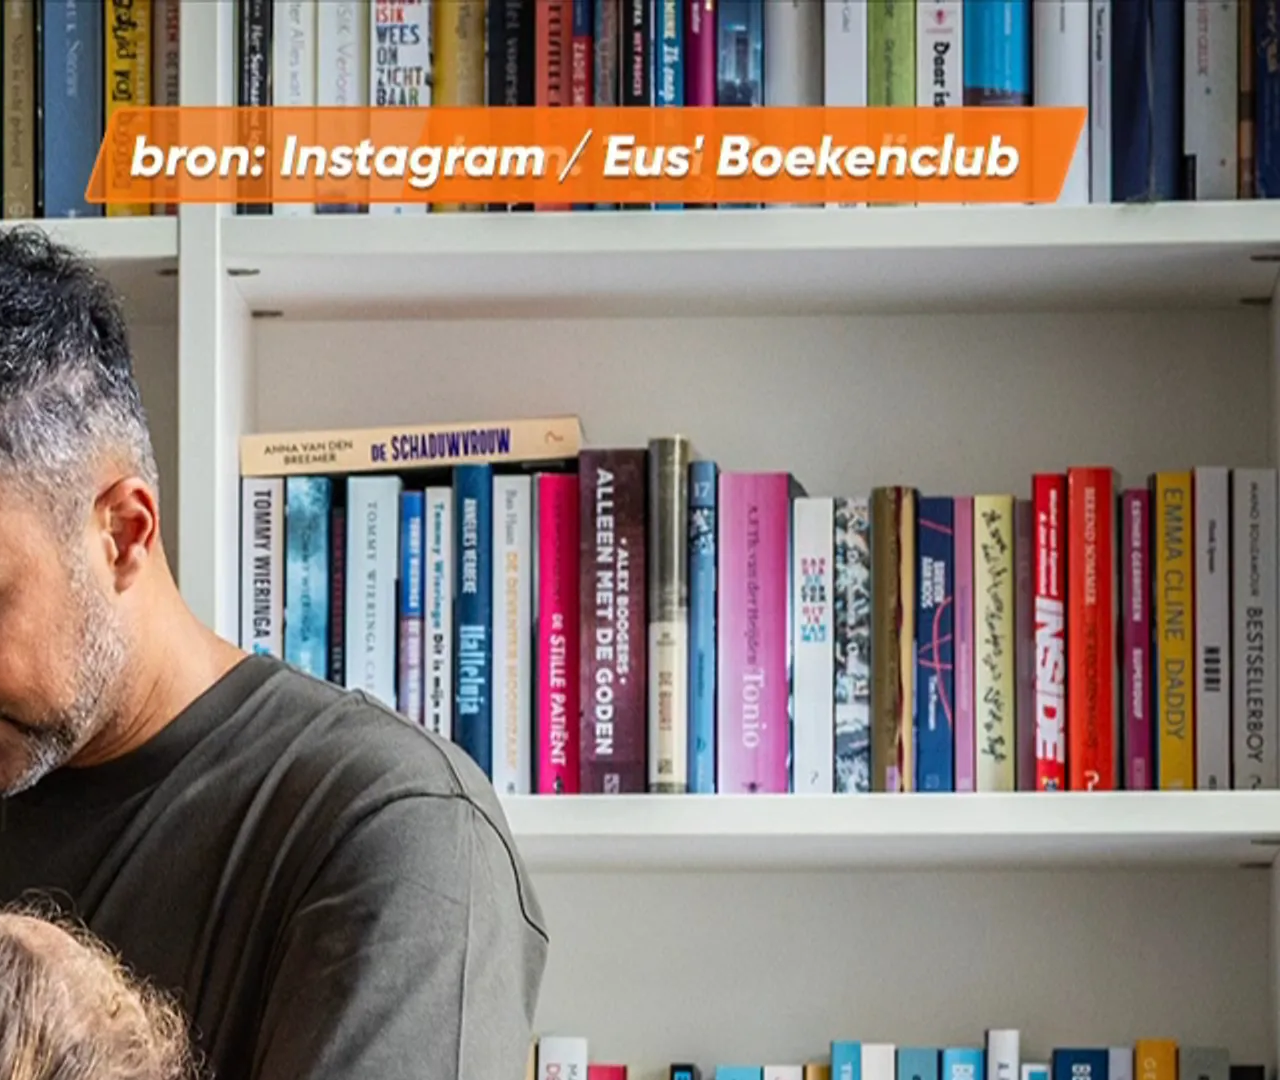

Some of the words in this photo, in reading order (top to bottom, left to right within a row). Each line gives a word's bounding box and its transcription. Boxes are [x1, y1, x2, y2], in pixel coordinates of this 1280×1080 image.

[254, 490, 271, 550] TOMMY
[596, 469, 613, 562] ALLEEN
[1164, 488, 1184, 561] EMMA
[254, 557, 271, 638] WIERINGA
[596, 571, 613, 620] MET
[616, 548, 629, 592] ALEX
[1164, 570, 1184, 641] CLINE
[456, 625, 486, 715] Halleluja
[550, 635, 565, 688] STILLE
[596, 628, 613, 661] DE
[616, 596, 629, 674] BOOGERS
[595, 668, 613, 755] GODEN
[1035, 596, 1064, 762] INSIDE
[1166, 659, 1184, 740] DADDY
[1246, 607, 1263, 762] BESTSELLERBOY
[550, 693, 569, 766] PATIËNT
